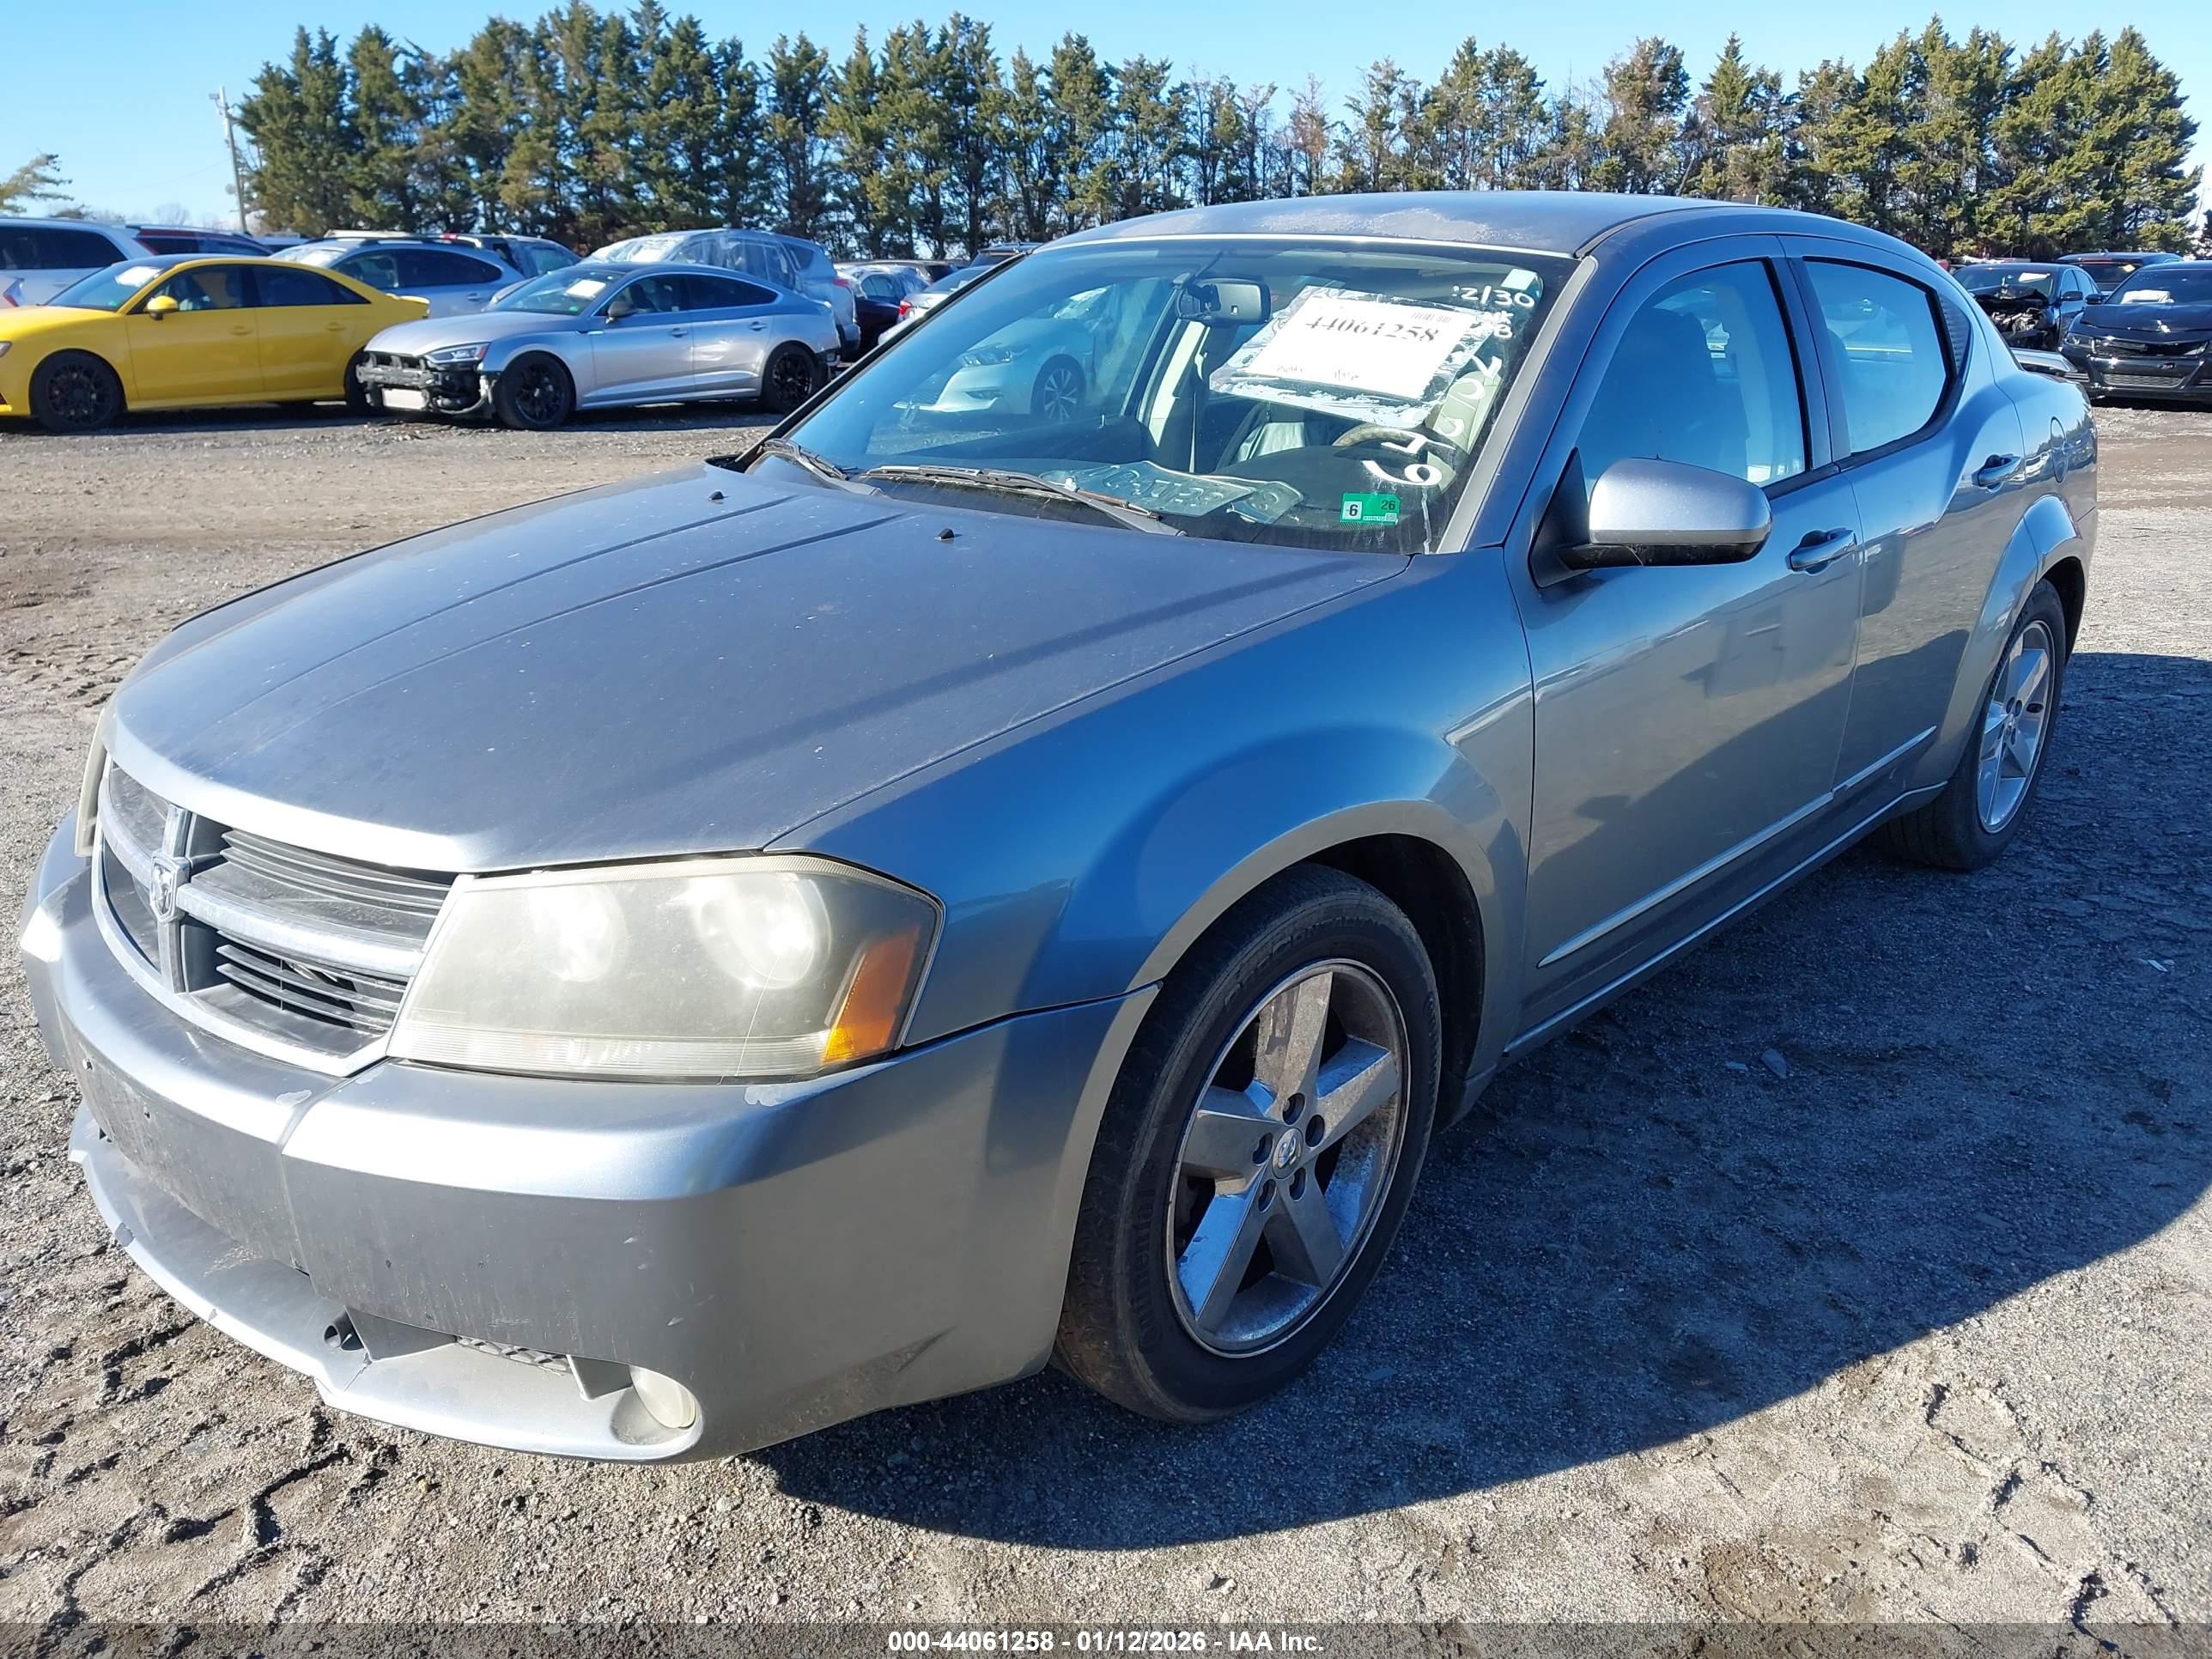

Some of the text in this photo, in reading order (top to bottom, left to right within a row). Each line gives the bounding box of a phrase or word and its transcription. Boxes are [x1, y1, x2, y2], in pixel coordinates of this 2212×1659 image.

[1305, 316, 1439, 342] 44061258
[1349, 500, 1396, 517] 6 26
